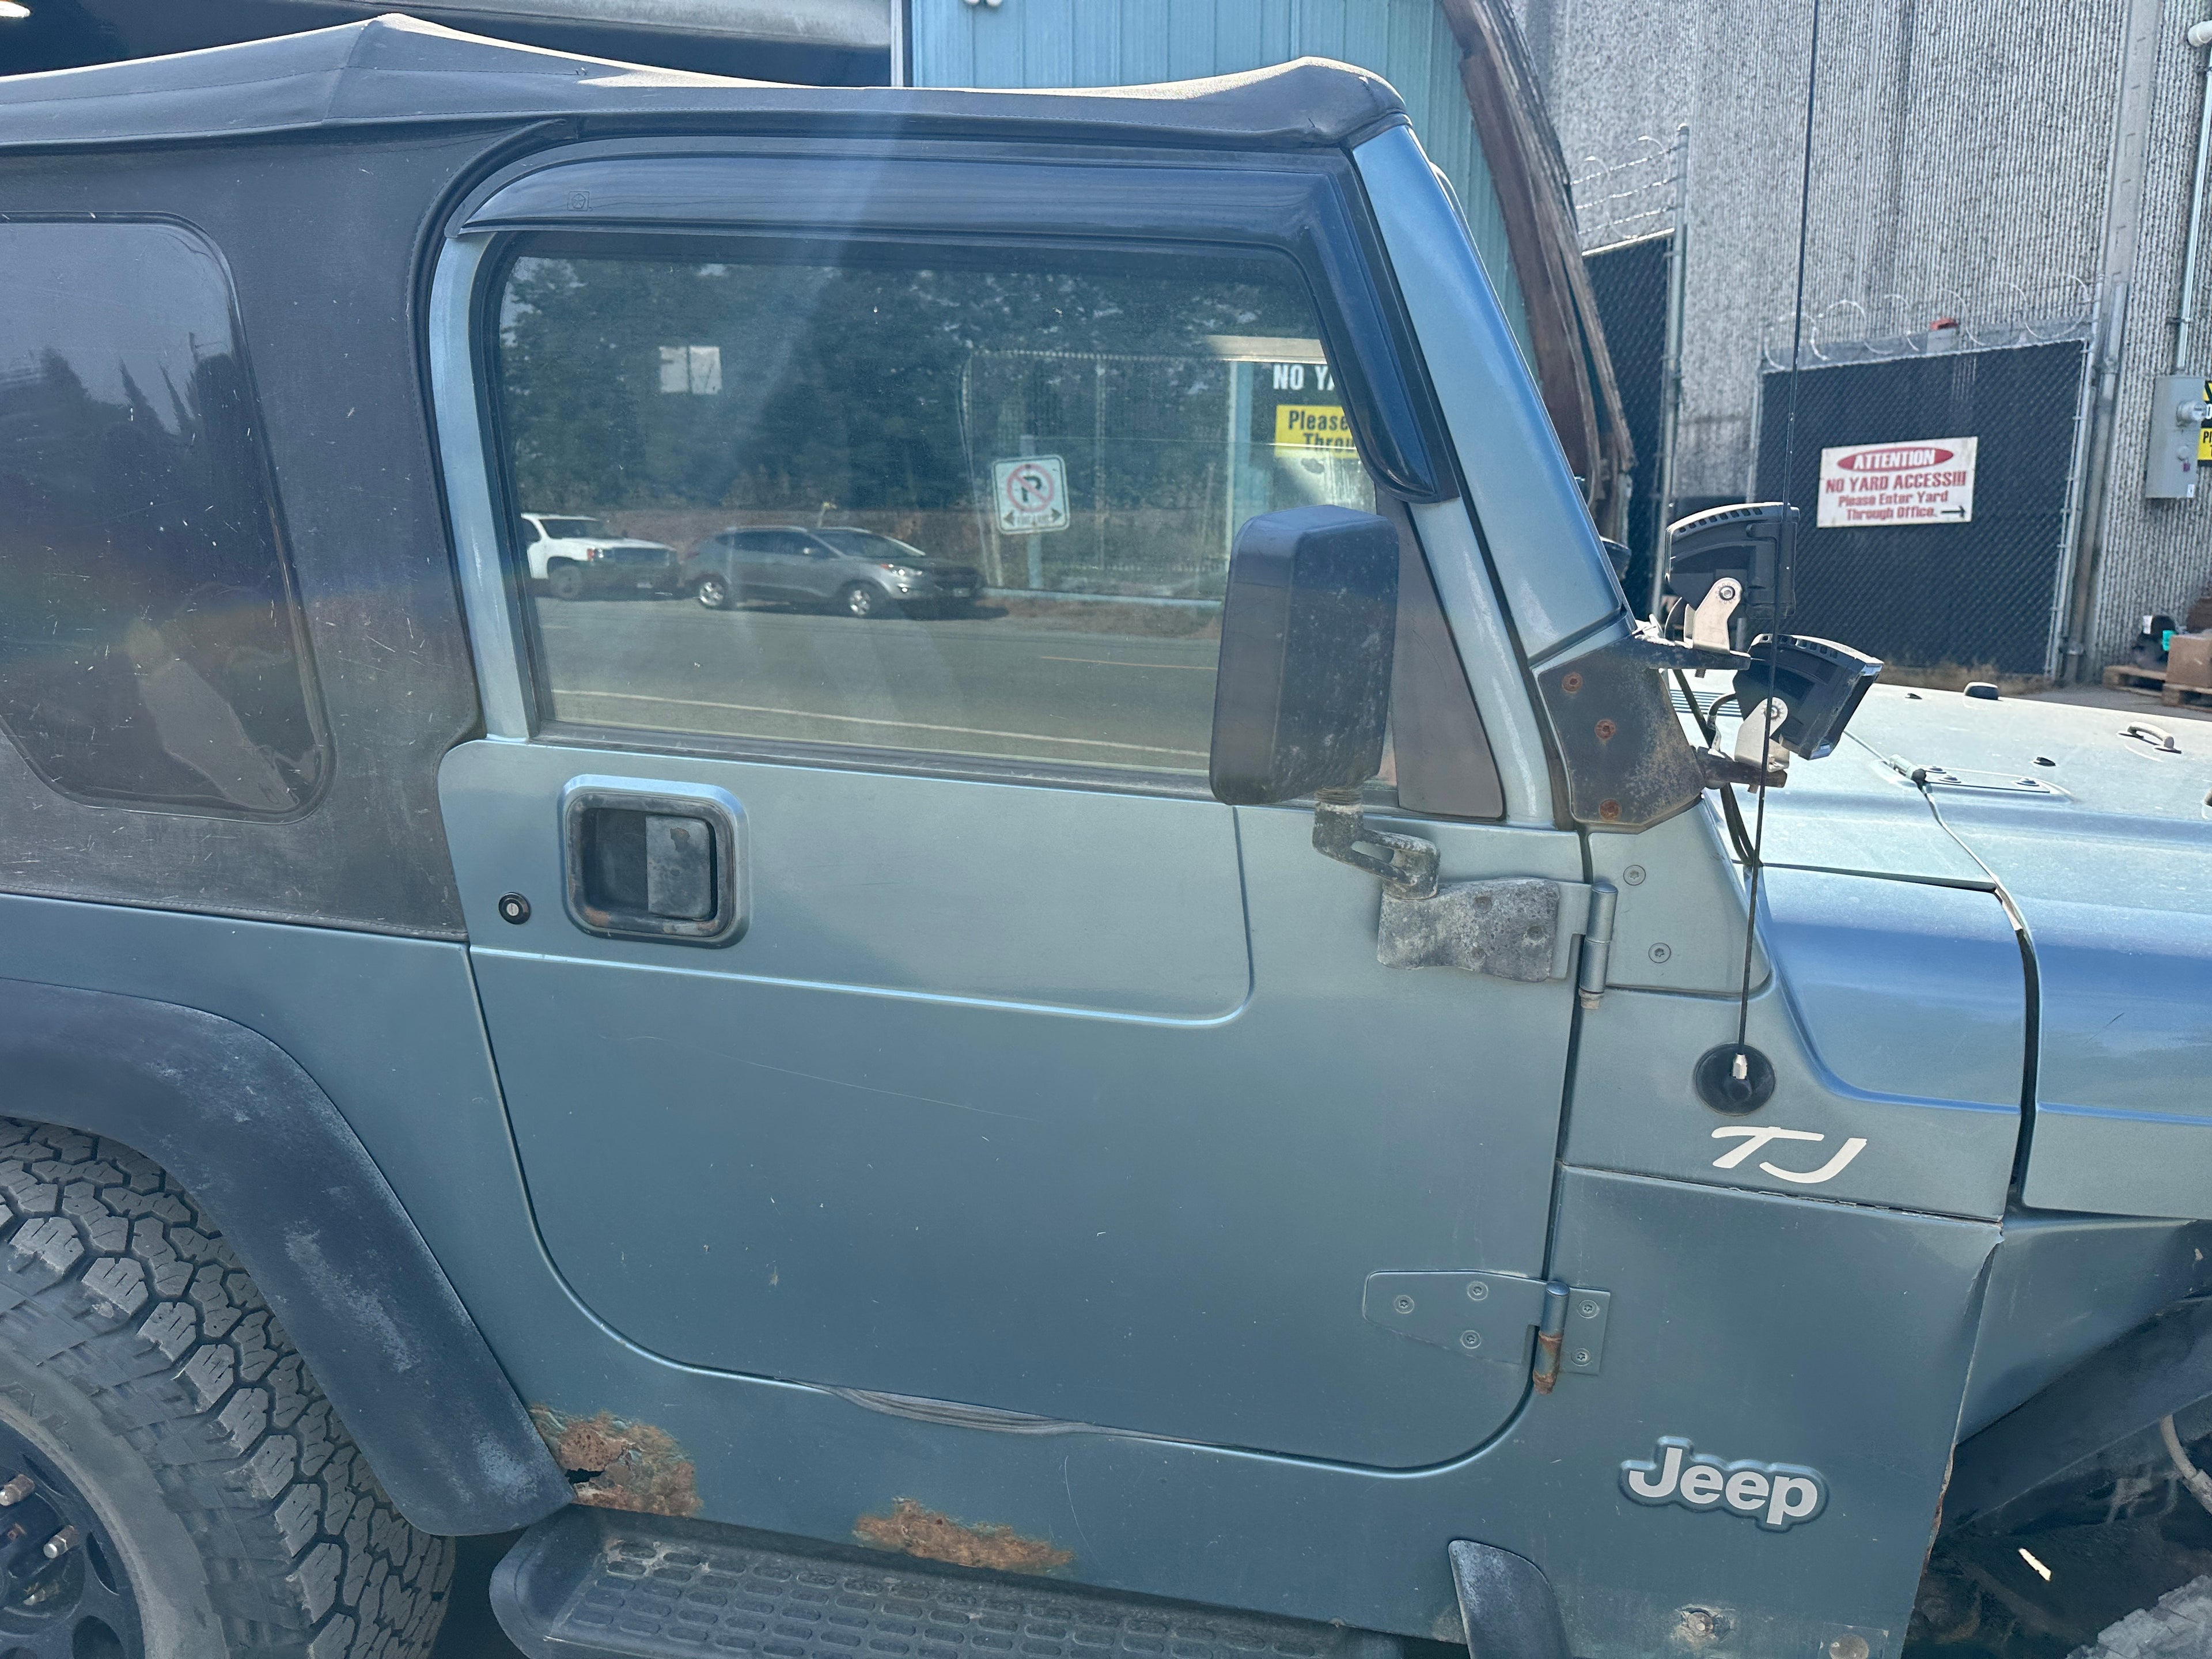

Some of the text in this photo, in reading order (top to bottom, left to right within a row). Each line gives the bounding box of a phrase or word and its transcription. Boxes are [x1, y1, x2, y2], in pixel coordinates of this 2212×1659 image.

[1273, 364, 1304, 390] NO
[1853, 449, 1936, 470] ATTENTION
[1825, 477, 1844, 494] NO
[1850, 475, 1888, 493] YARD
[1838, 490, 1948, 507] Please Enter Yard
[1846, 507, 1893, 521] Through
[1711, 1126, 1867, 1184] TJ
[1628, 1447, 1817, 1525] Jeep
